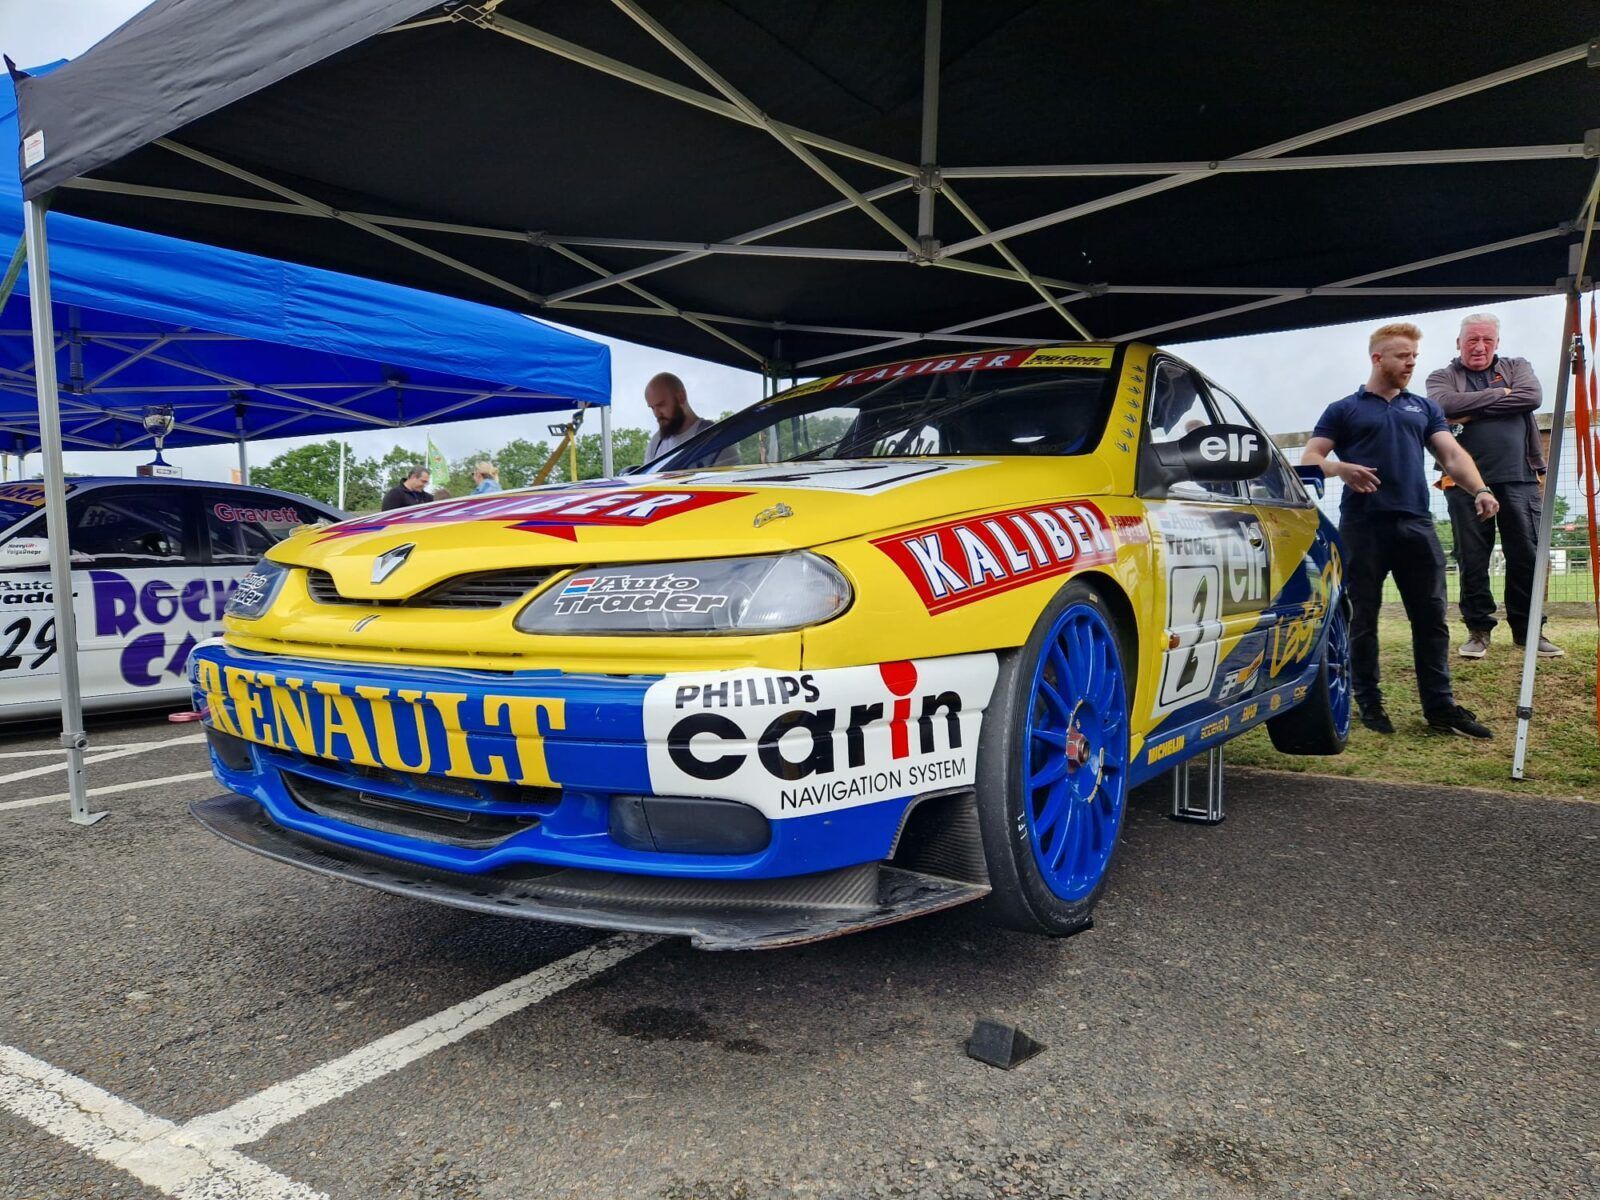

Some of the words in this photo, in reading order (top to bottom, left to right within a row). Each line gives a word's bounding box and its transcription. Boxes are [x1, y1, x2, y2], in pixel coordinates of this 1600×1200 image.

[838, 355, 1013, 388] KALIBER
[1200, 433, 1258, 462] elf
[214, 502, 301, 523] Gravett
[904, 505, 1112, 599] KALIBER
[1165, 533, 1217, 555] Trader
[1227, 520, 1267, 603] elf
[592, 573, 700, 592] Auto
[554, 590, 728, 615] Trader
[675, 674, 820, 709] PHILIPS
[199, 659, 566, 789] RENAULT
[667, 659, 963, 781] carin
[780, 770, 902, 811] NAVIGATION
[909, 757, 967, 786] SYSTEM
